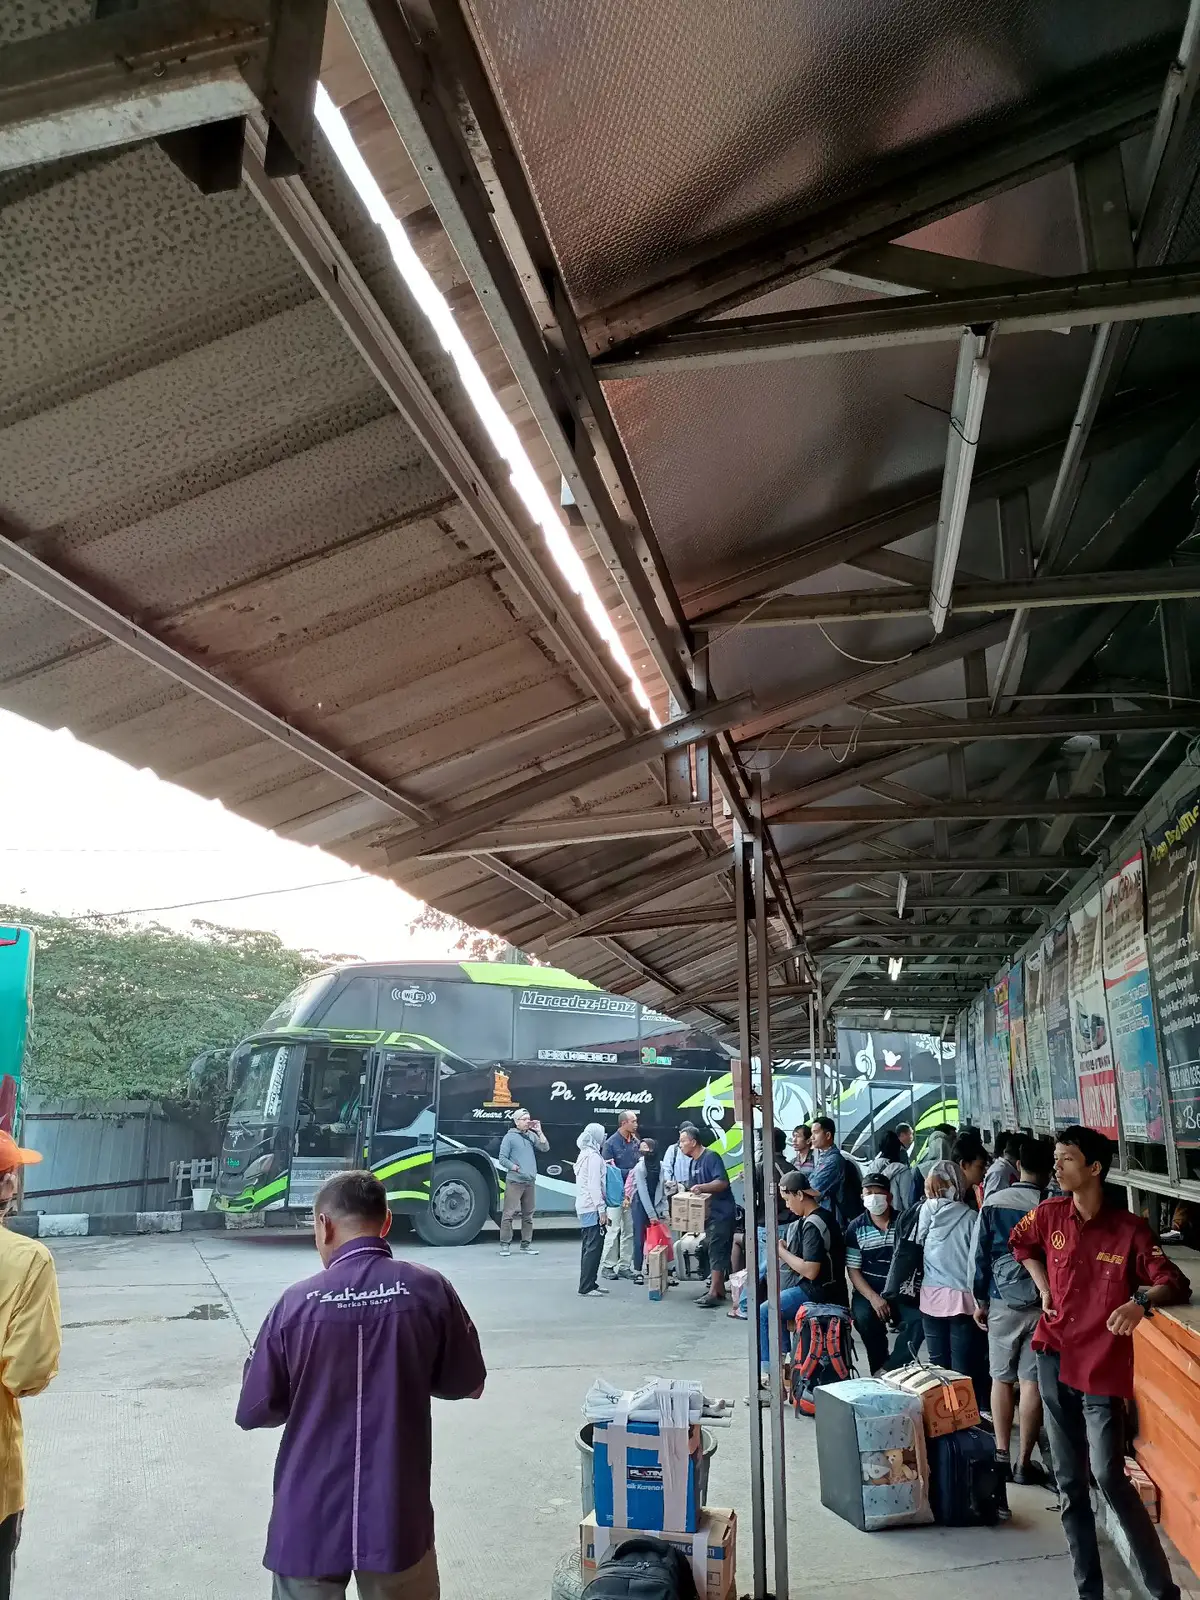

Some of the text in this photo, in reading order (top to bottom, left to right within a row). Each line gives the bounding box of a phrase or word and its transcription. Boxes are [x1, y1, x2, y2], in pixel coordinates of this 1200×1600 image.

[641, 1047, 657, 1065] 30
[584, 1082, 654, 1108] Haryanto
[472, 1108, 503, 1119] Menara
[337, 1300, 368, 1309] Berkah
